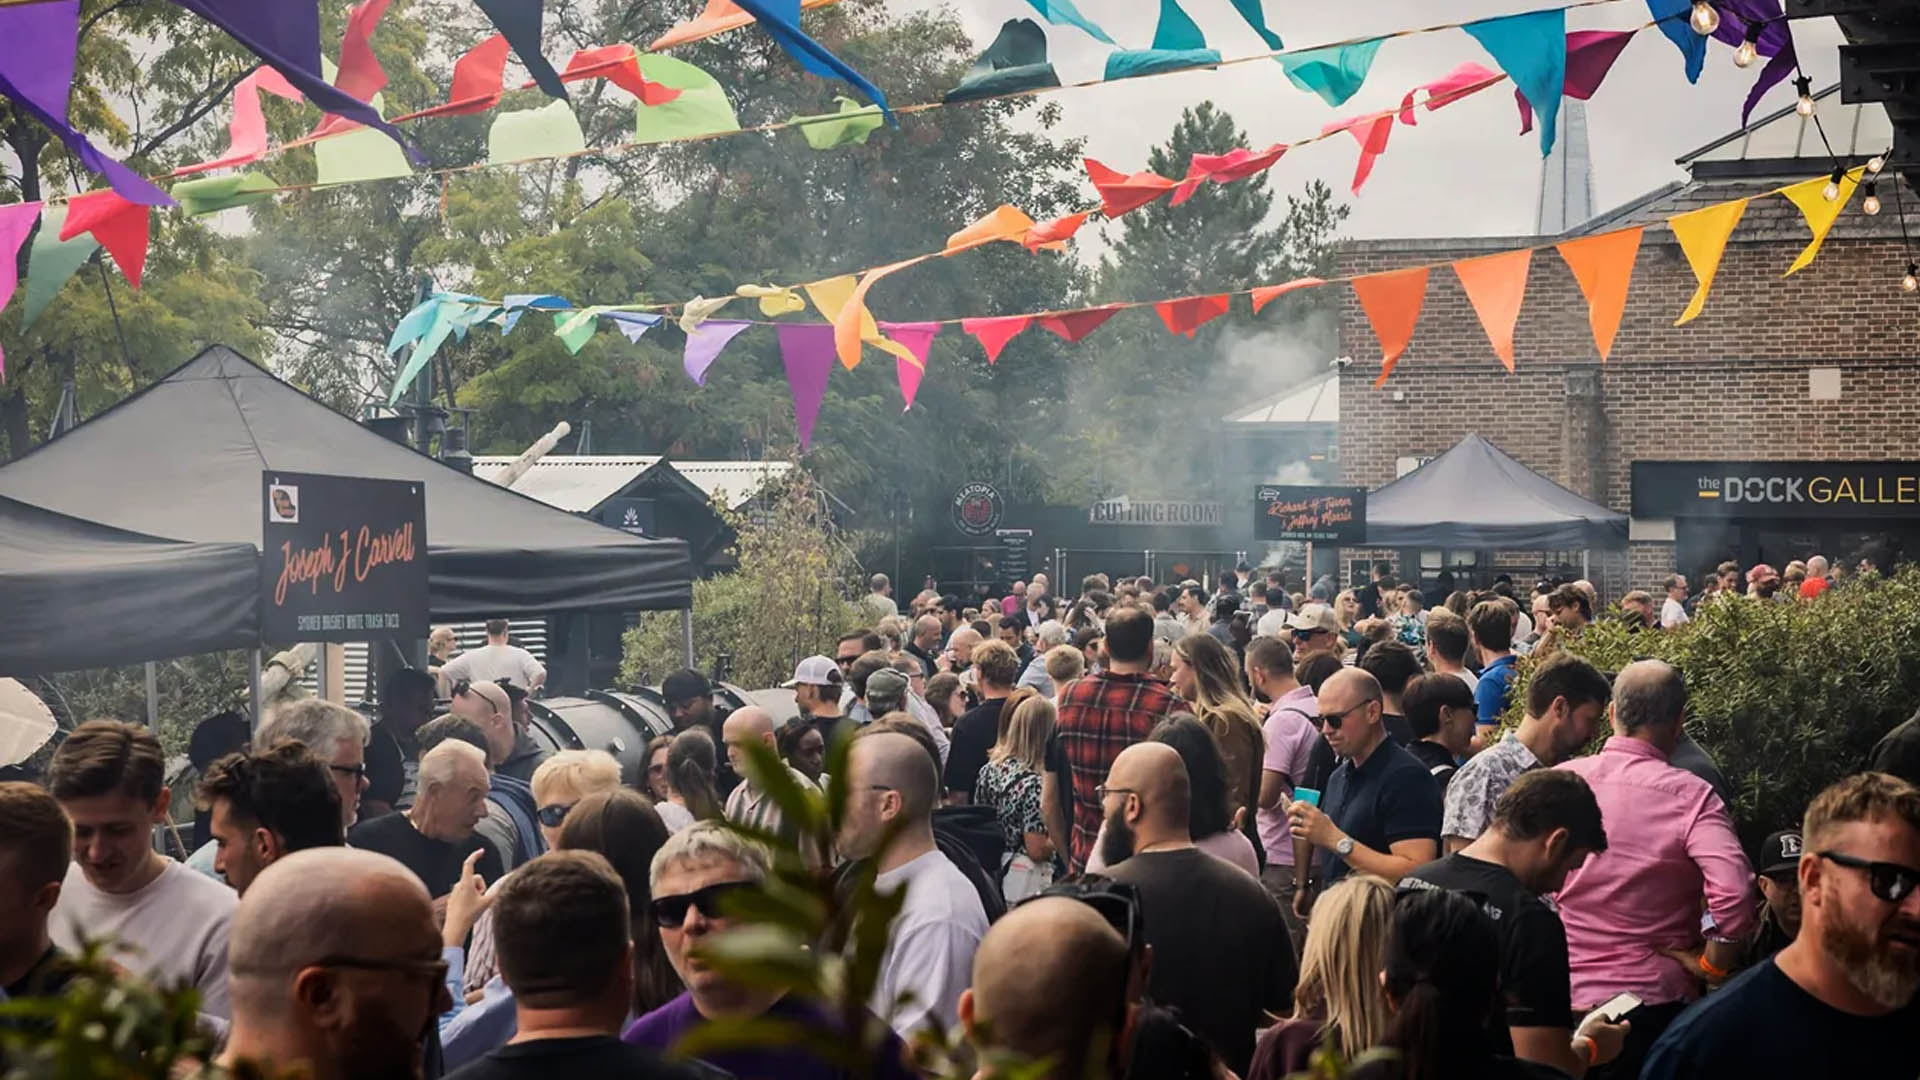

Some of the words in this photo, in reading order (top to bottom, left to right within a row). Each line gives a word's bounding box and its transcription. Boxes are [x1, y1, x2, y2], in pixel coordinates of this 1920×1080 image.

[955, 484, 995, 506] MEATOPIA
[1698, 476, 1720, 489] the
[1725, 477, 1804, 503] DOCK
[1808, 476, 1920, 503] GALLE
[1095, 502, 1164, 521] CUTTING
[1167, 502, 1218, 521] ROOM
[275, 531, 335, 606] Joseph
[335, 530, 351, 593] J
[354, 521, 415, 582] Carvell
